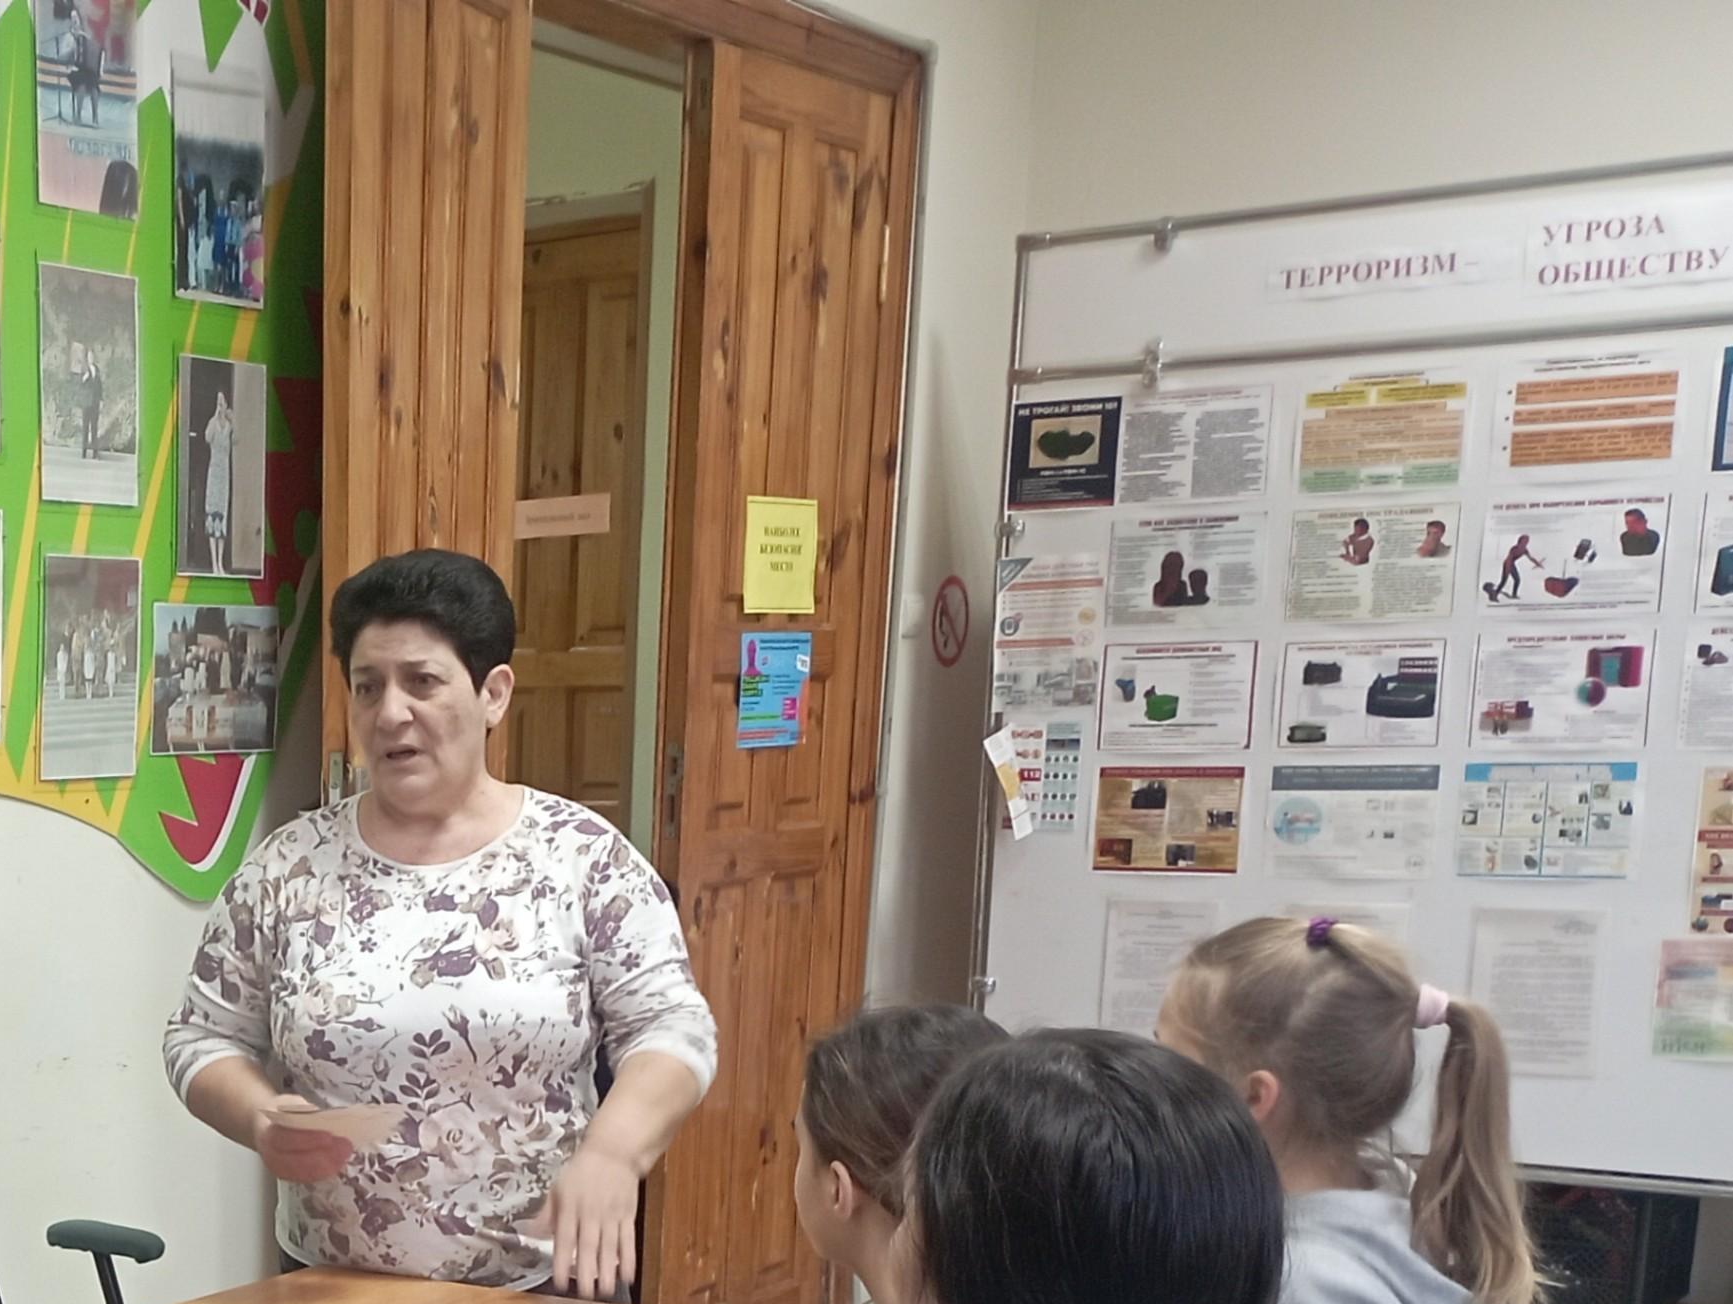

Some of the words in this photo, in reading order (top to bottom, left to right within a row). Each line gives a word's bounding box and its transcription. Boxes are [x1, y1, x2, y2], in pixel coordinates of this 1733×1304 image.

[1542, 213, 1666, 247] УГРОЗА
[1279, 251, 1458, 291] ТЕРРОРИЗМ
[1537, 246, 1731, 288] ОБЩЕСТВУ
